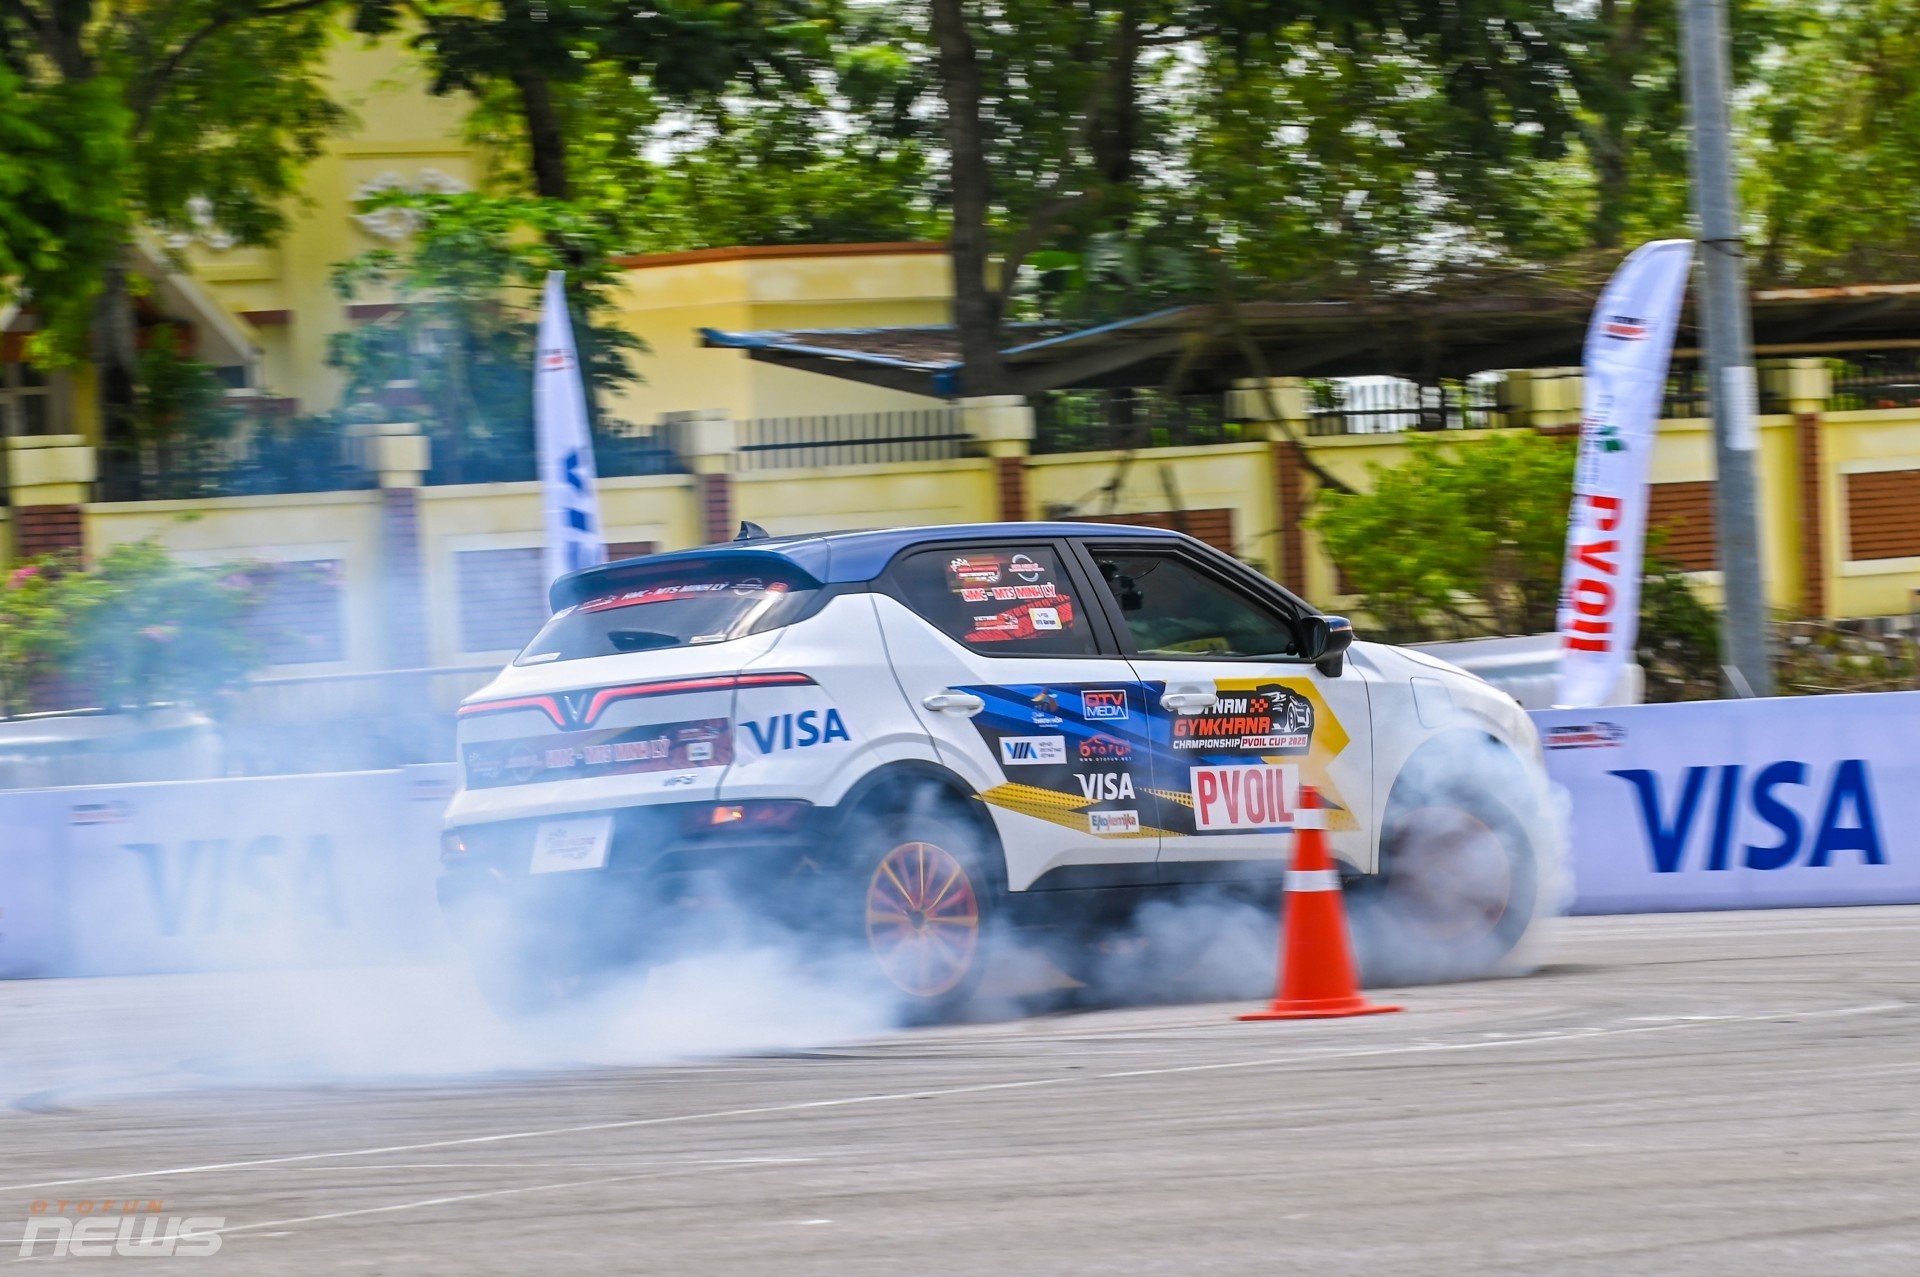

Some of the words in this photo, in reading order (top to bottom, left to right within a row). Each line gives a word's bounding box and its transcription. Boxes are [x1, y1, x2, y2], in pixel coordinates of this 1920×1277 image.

[992, 587, 1016, 601] MTS
[1014, 585, 1043, 599] MINH
[738, 708, 851, 754] VISA
[1173, 716, 1271, 737] GYMKHANA
[1173, 738, 1241, 750] CHAMPIONSHIP
[1242, 737, 1267, 747] PVOIL
[1269, 737, 1287, 747] CUP
[1073, 772, 1136, 800] VISA
[1196, 769, 1295, 825] PVOIL
[1603, 759, 1890, 873] VISA
[118, 833, 349, 937] VISA
